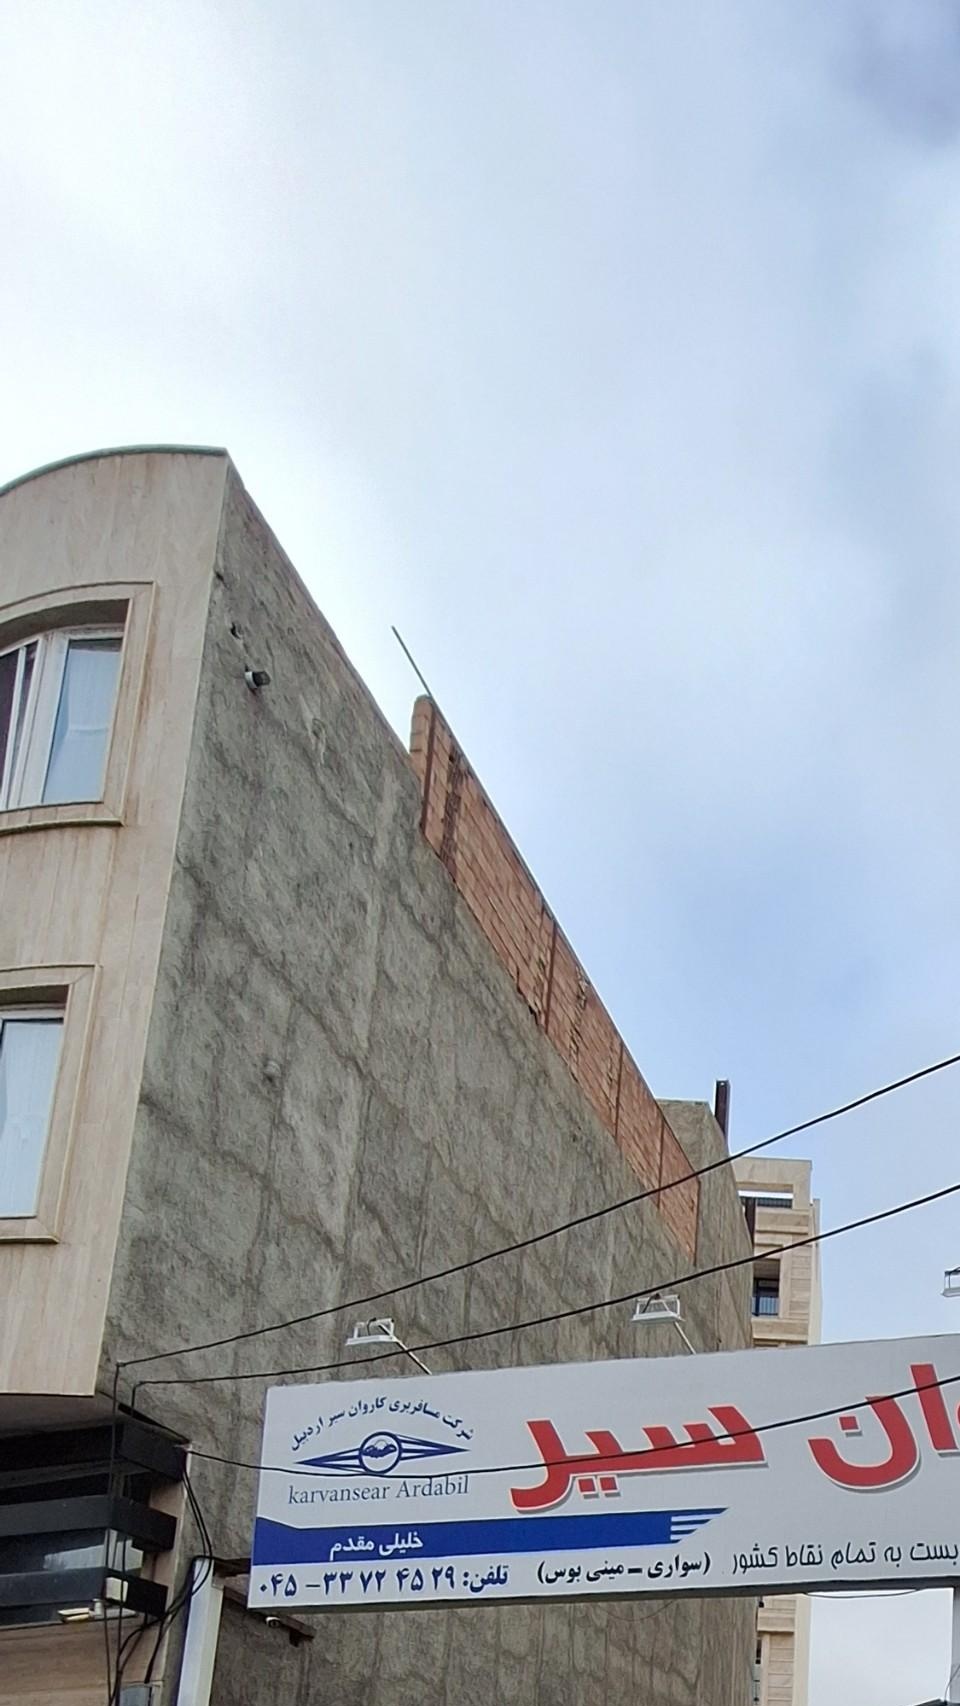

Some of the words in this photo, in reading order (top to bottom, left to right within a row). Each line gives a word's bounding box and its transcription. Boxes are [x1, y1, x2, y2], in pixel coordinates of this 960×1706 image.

[328, 1410, 346, 1428] سیر
[348, 1396, 387, 1418] کاروان
[389, 1399, 440, 1420] مسافربری
[291, 1417, 324, 1452] اردبیل
[442, 1414, 475, 1441] شرکت
[510, 1406, 768, 1511] سیر
[288, 1485, 391, 1504] karvansear
[396, 1475, 470, 1498] Ardabil
[330, 1536, 375, 1561] مقدم
[378, 1531, 424, 1556] خلیلی
[785, 1543, 823, 1568] نقاط
[830, 1541, 876, 1570] تمام
[732, 1542, 778, 1575] کشور
[884, 1545, 902, 1568] به
[586, 1560, 624, 1582] مینی
